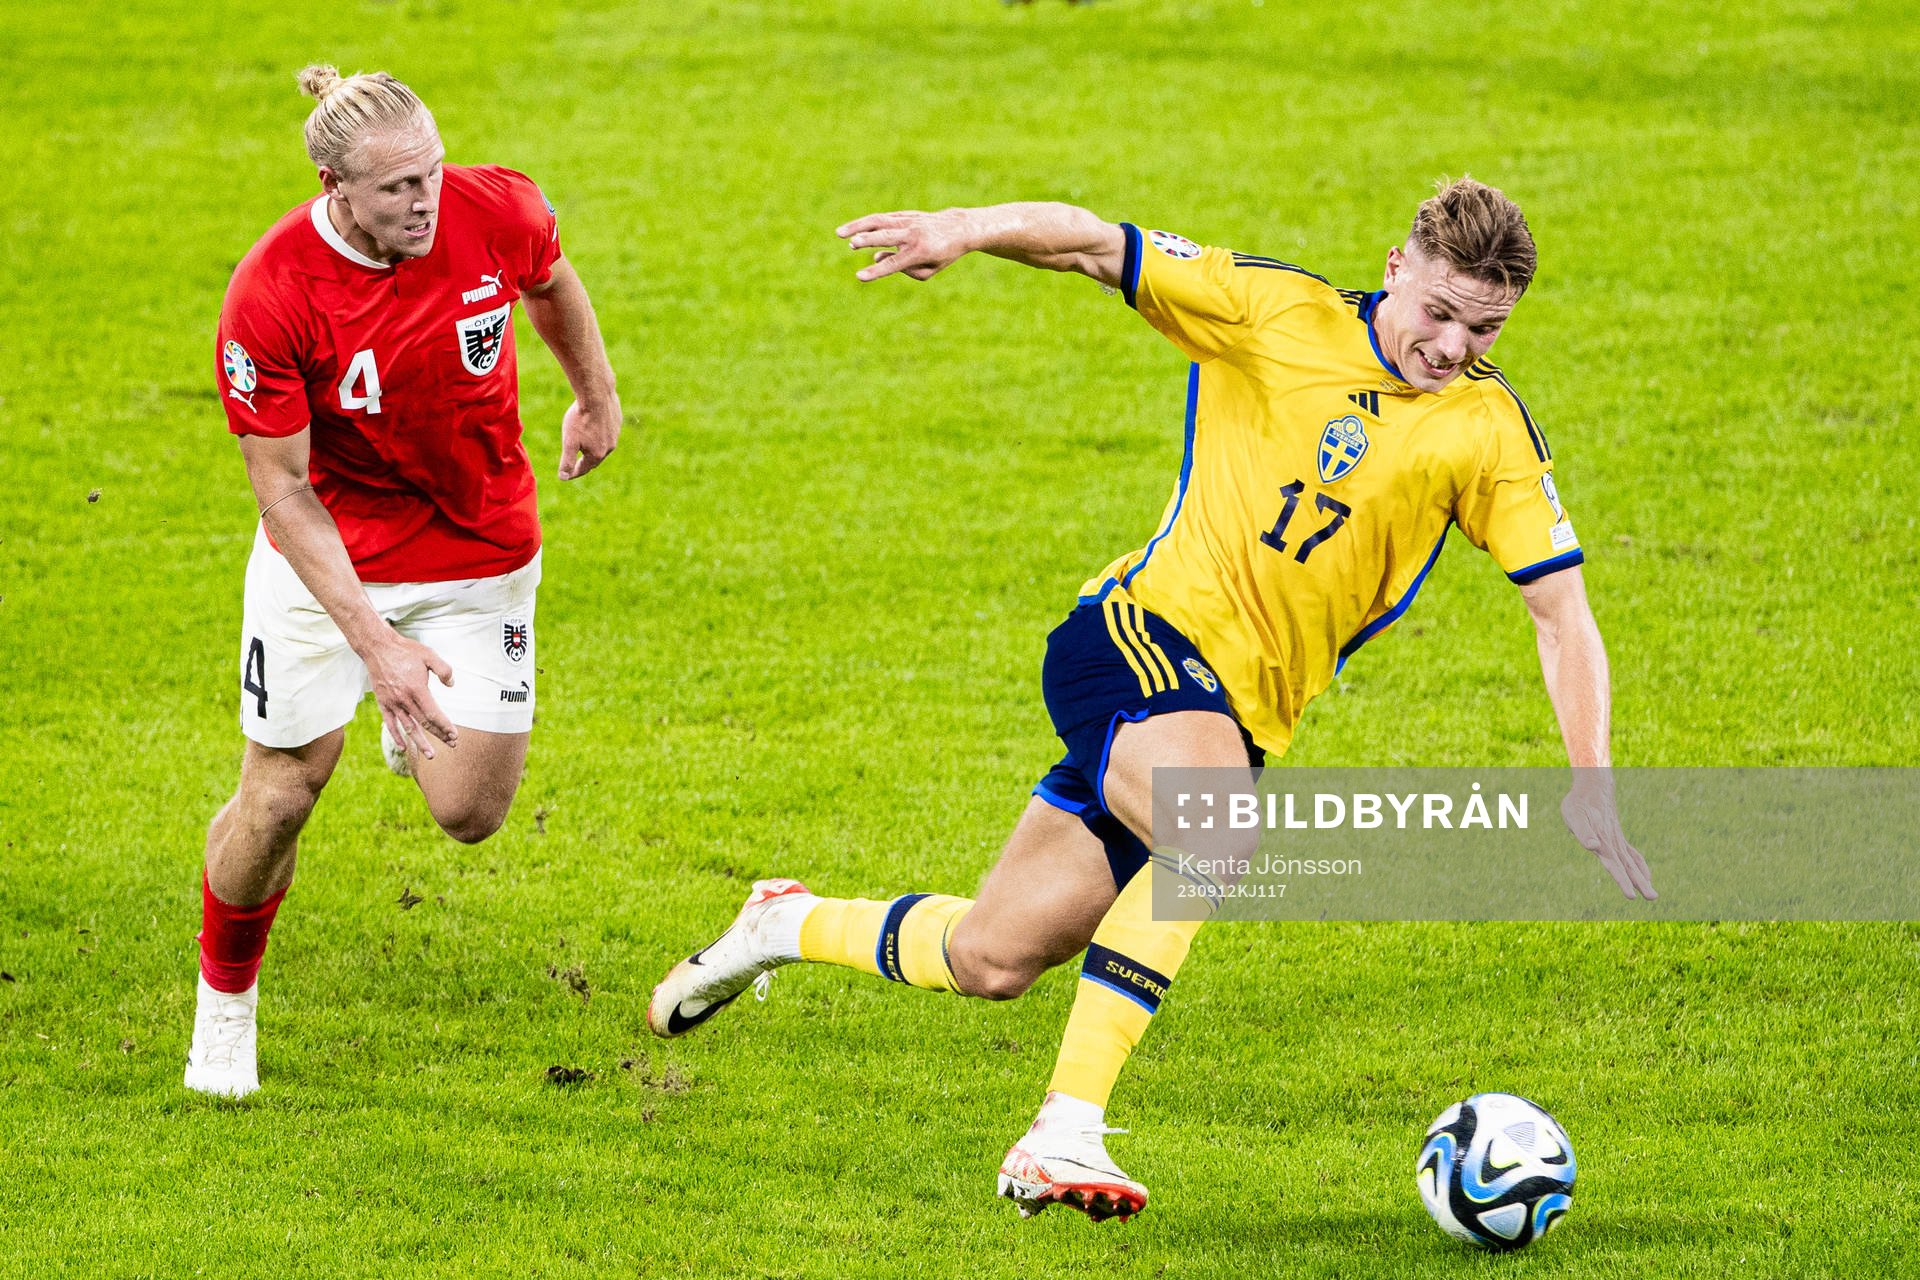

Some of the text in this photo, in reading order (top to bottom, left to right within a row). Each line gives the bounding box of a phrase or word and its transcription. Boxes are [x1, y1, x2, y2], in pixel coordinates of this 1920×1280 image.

[461, 283, 498, 305] PUMA
[338, 348, 382, 414] 4
[1259, 478, 1352, 565] 17
[243, 636, 268, 720] 4
[500, 689, 528, 703] PUMA
